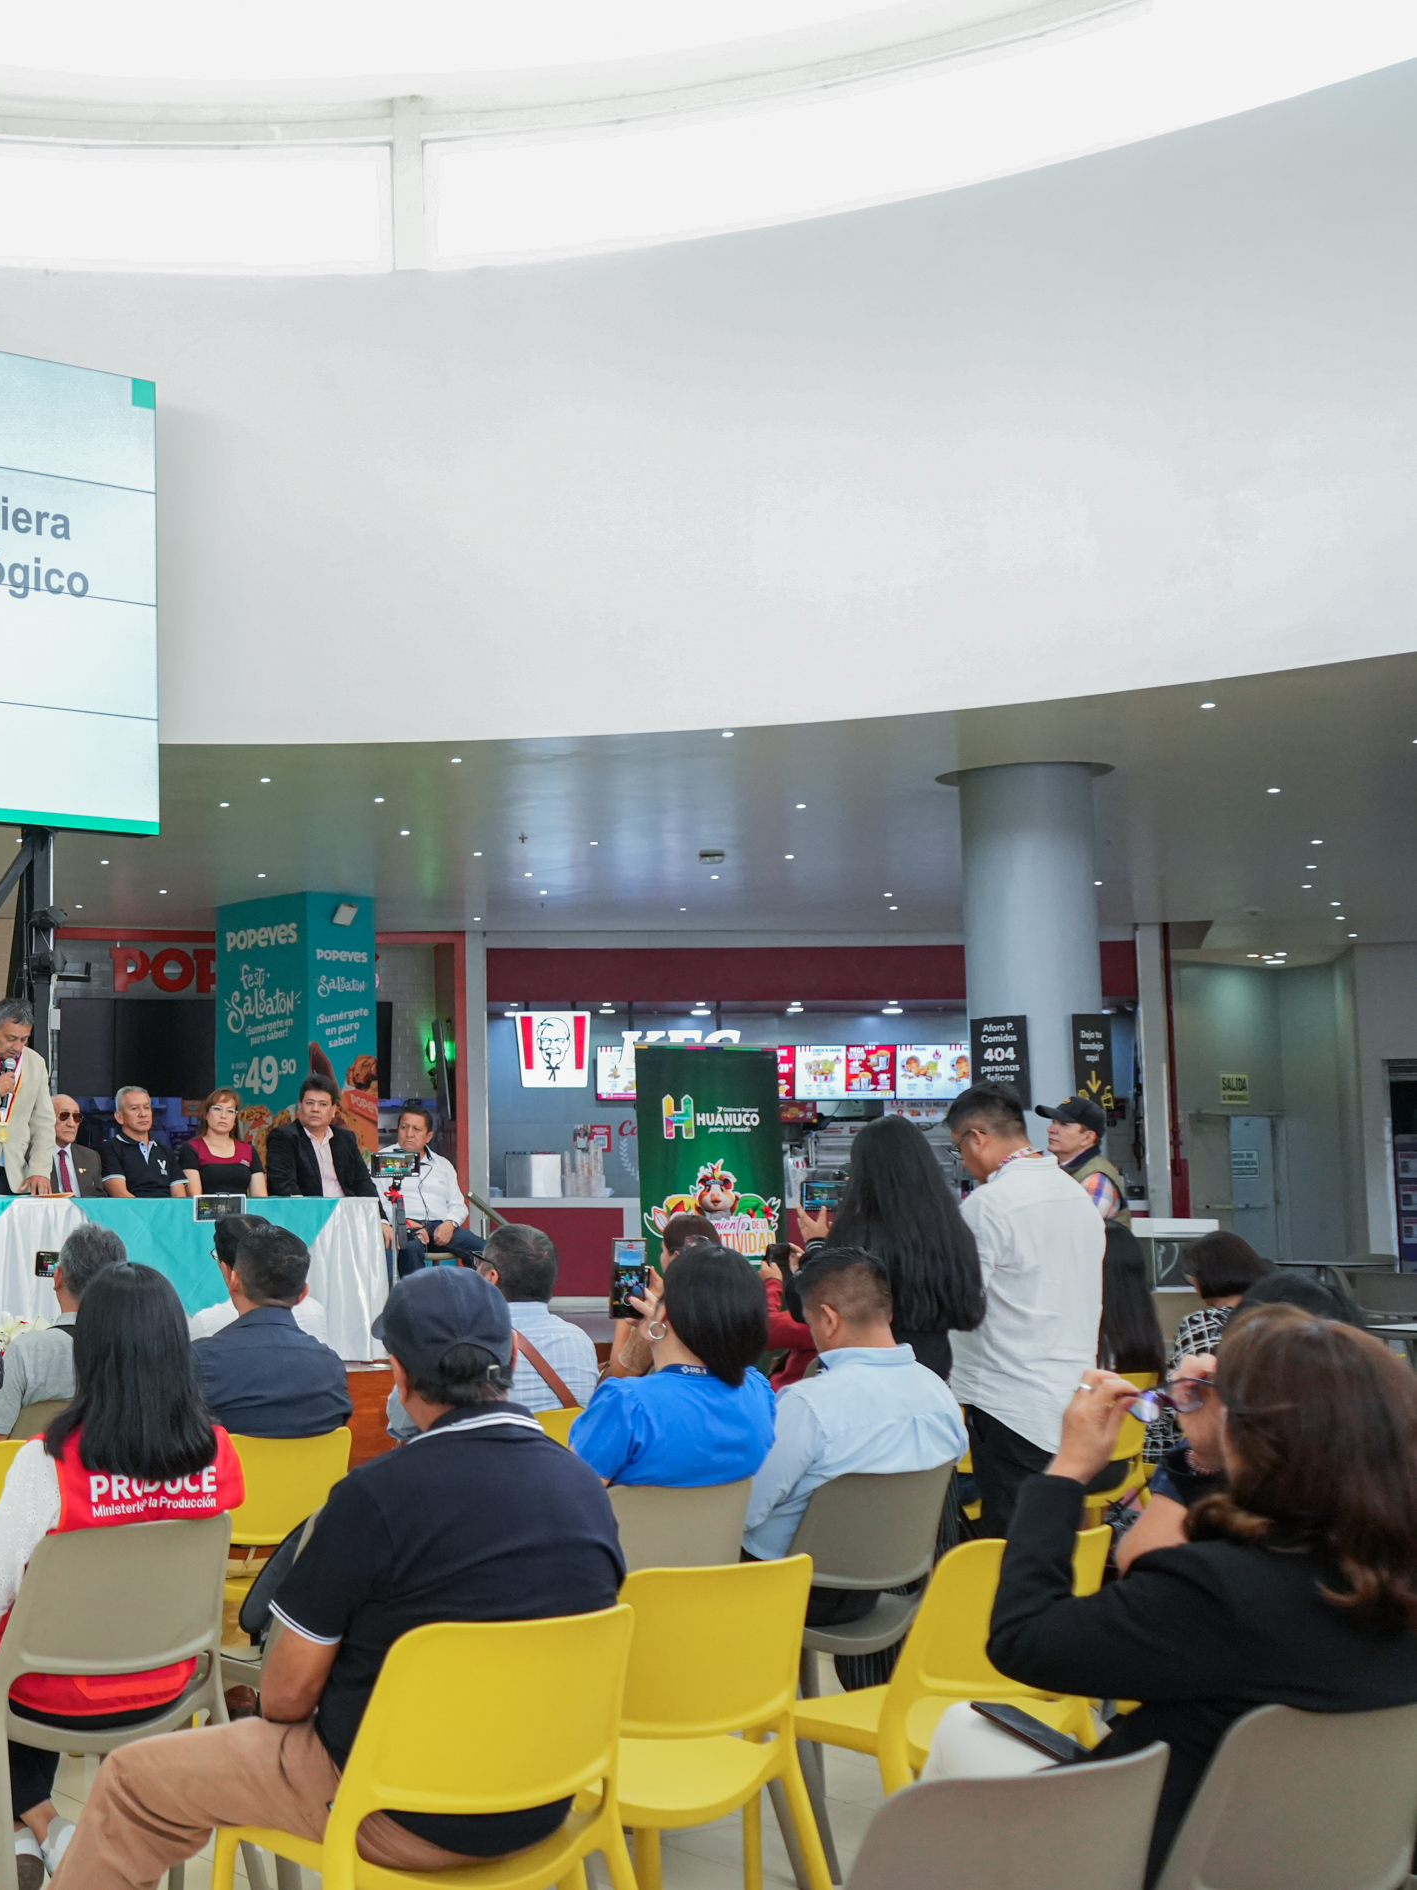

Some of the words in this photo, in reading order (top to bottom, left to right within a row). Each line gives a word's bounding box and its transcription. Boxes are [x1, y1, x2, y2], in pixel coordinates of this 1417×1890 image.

[325, 1026, 337, 1036] en
[338, 1022, 360, 1036] puro
[983, 1023, 1005, 1032] Aforo
[1007, 1022, 1014, 1031] P.
[328, 1034, 357, 1048] sabor!
[980, 1034, 1017, 1043] Comidas
[984, 1047, 1016, 1061] 404
[980, 1064, 1020, 1074] personas
[1222, 1077, 1247, 1091] SALIDA
[696, 1111, 760, 1126] HUÁNUCO
[148, 1497, 158, 1508] la
[159, 1494, 217, 1509] Producción
